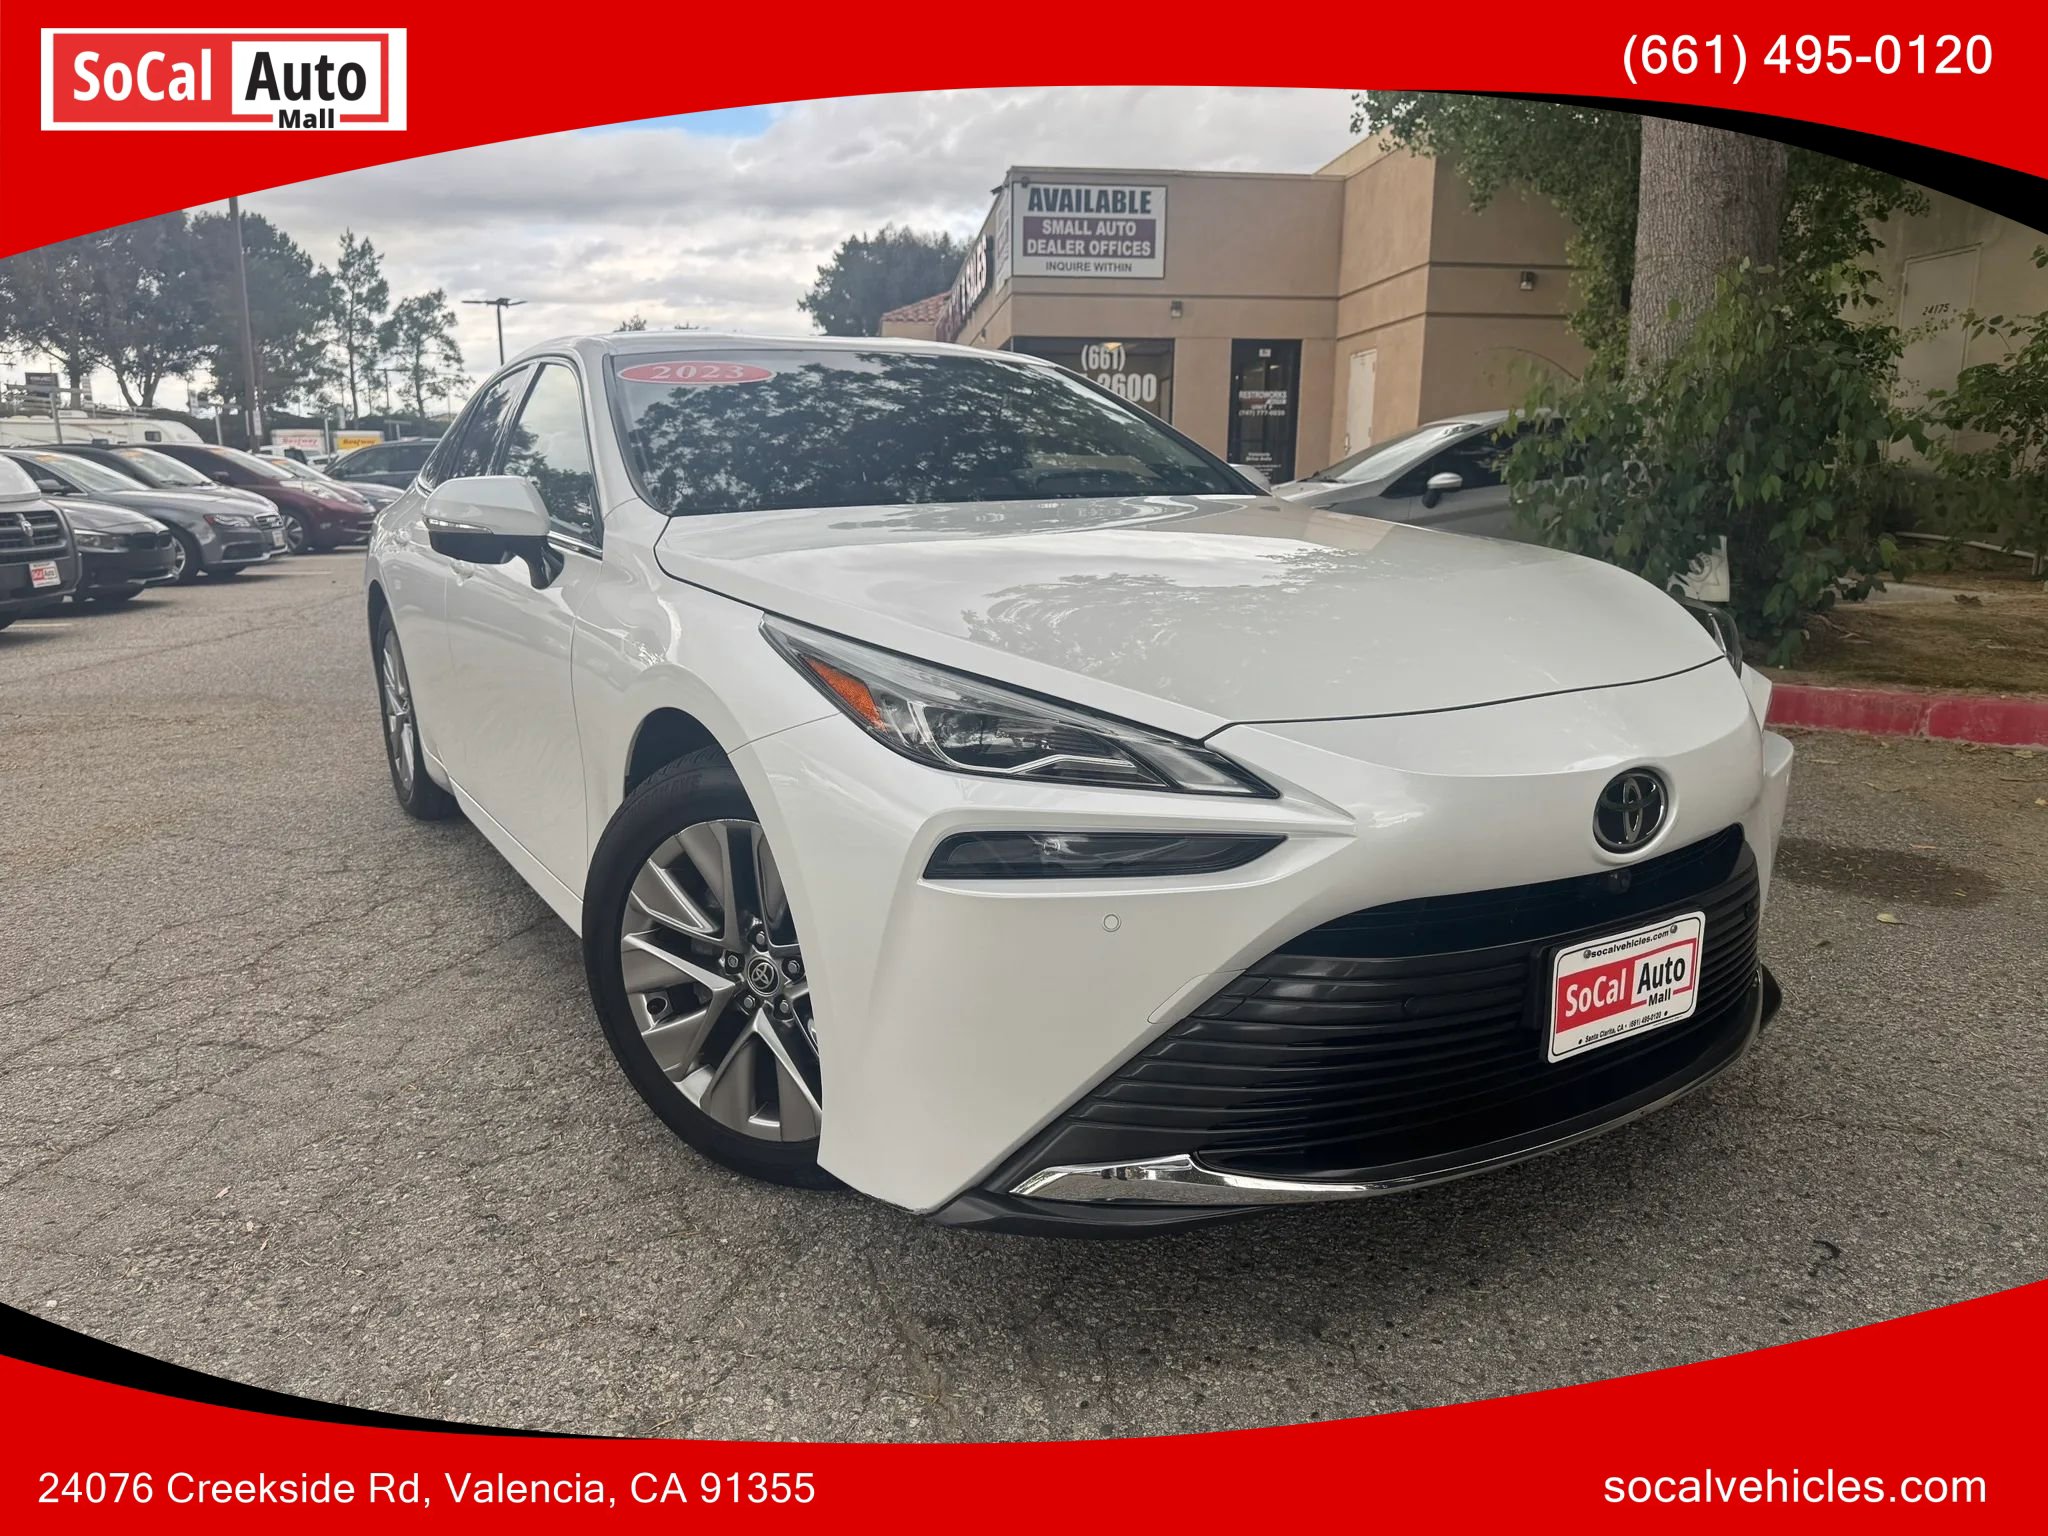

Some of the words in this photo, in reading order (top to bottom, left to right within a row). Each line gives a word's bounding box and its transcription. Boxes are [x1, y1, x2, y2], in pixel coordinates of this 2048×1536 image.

[1028, 187, 1153, 214] AVAILABLE
[1042, 219, 1092, 235] SMALL
[1095, 221, 1137, 236] AUTO
[1027, 239, 1086, 254] DEALER
[1089, 240, 1151, 256] OFFICES
[1045, 261, 1092, 272] INQUIRE
[1094, 262, 1132, 272] WITHIN
[1081, 344, 1126, 371] (661)
[650, 365, 745, 380] 2023
[1591, 929, 1669, 958] socalvehicles.com
[1565, 967, 1627, 1017] SoCal
[1637, 957, 1686, 994] Auto
[1648, 988, 1671, 1007] Mall
[1617, 1023, 1624, 1032] CA
